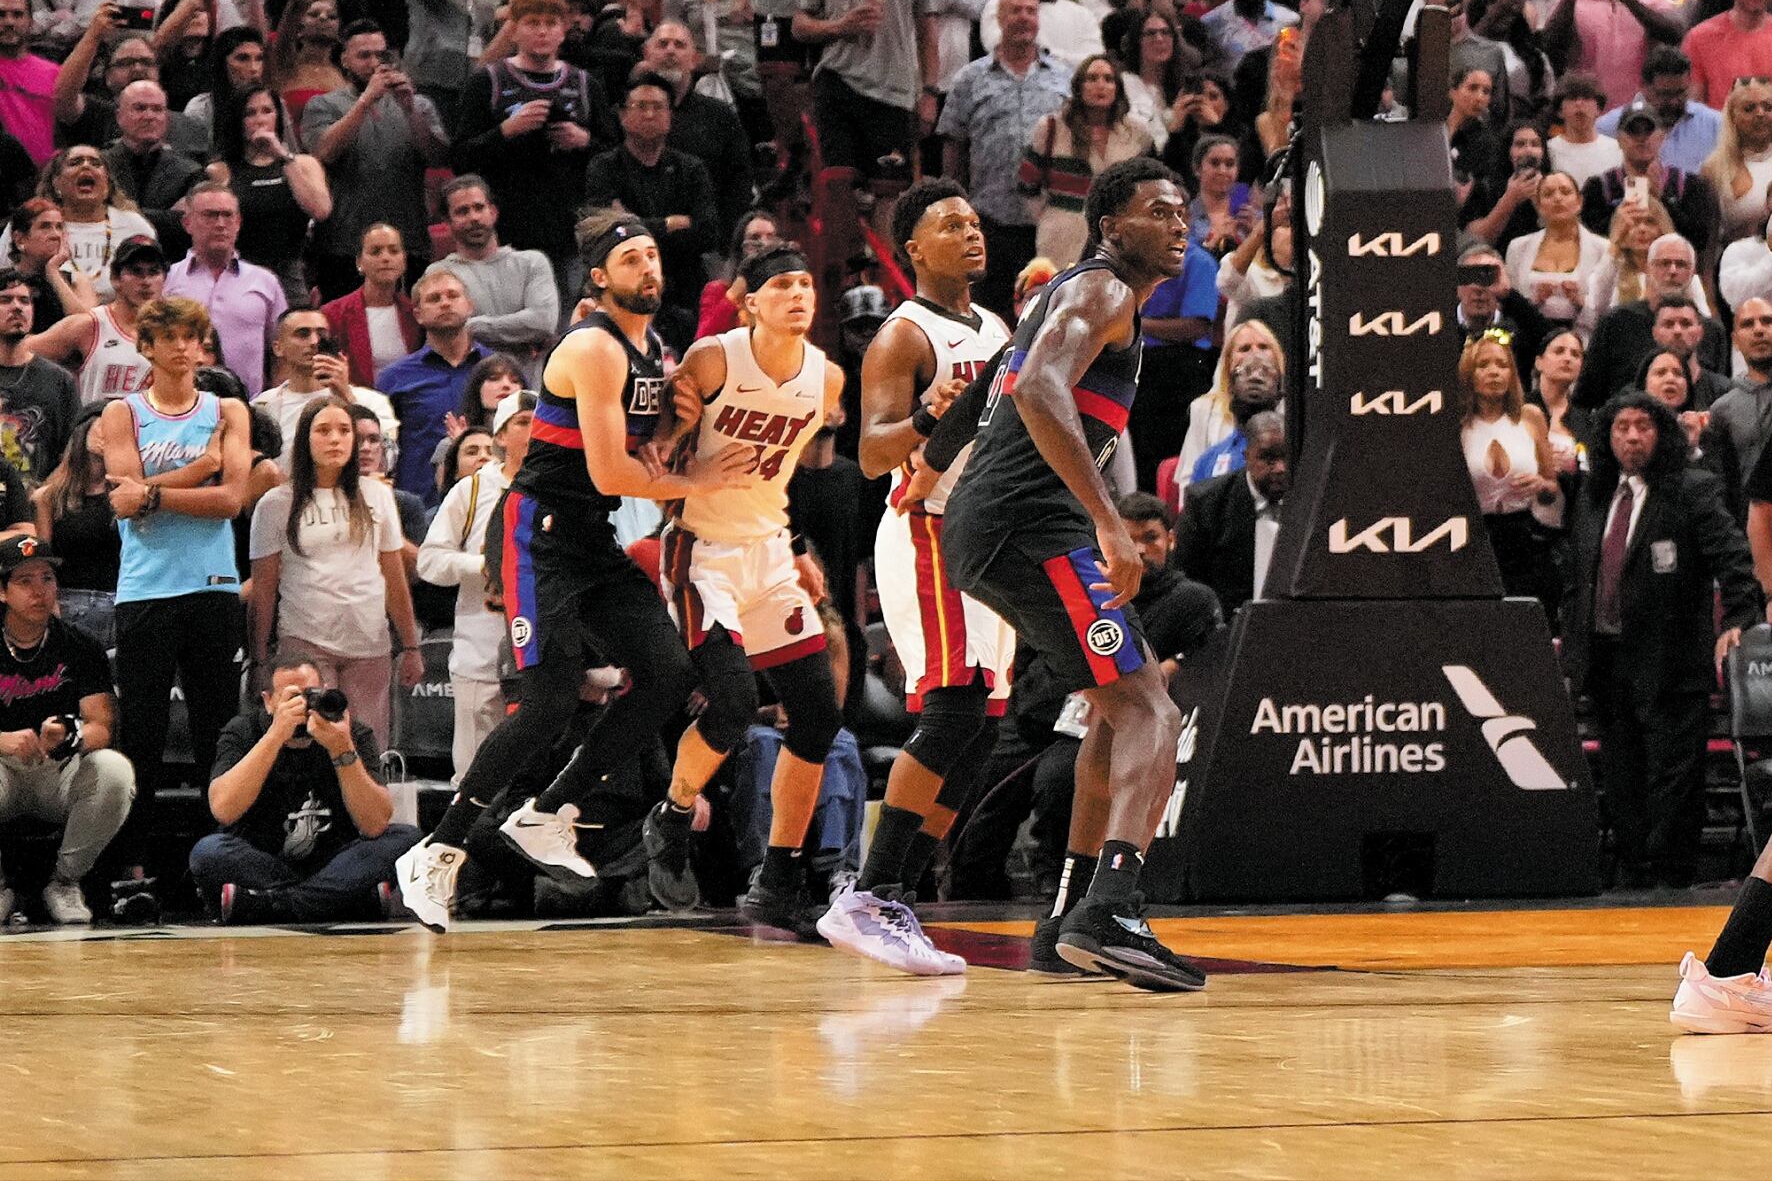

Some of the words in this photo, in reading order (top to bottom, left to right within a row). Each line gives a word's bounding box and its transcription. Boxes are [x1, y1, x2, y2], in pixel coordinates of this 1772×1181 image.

[1347, 231, 1441, 257] KIA
[1308, 247, 1322, 390] AT&T
[1349, 310, 1442, 337] KIA
[1350, 389, 1443, 416] KIA
[713, 404, 816, 448] HEAT
[1328, 516, 1468, 554] KIA
[1250, 694, 1446, 734] American
[1289, 735, 1448, 776] Airlines
